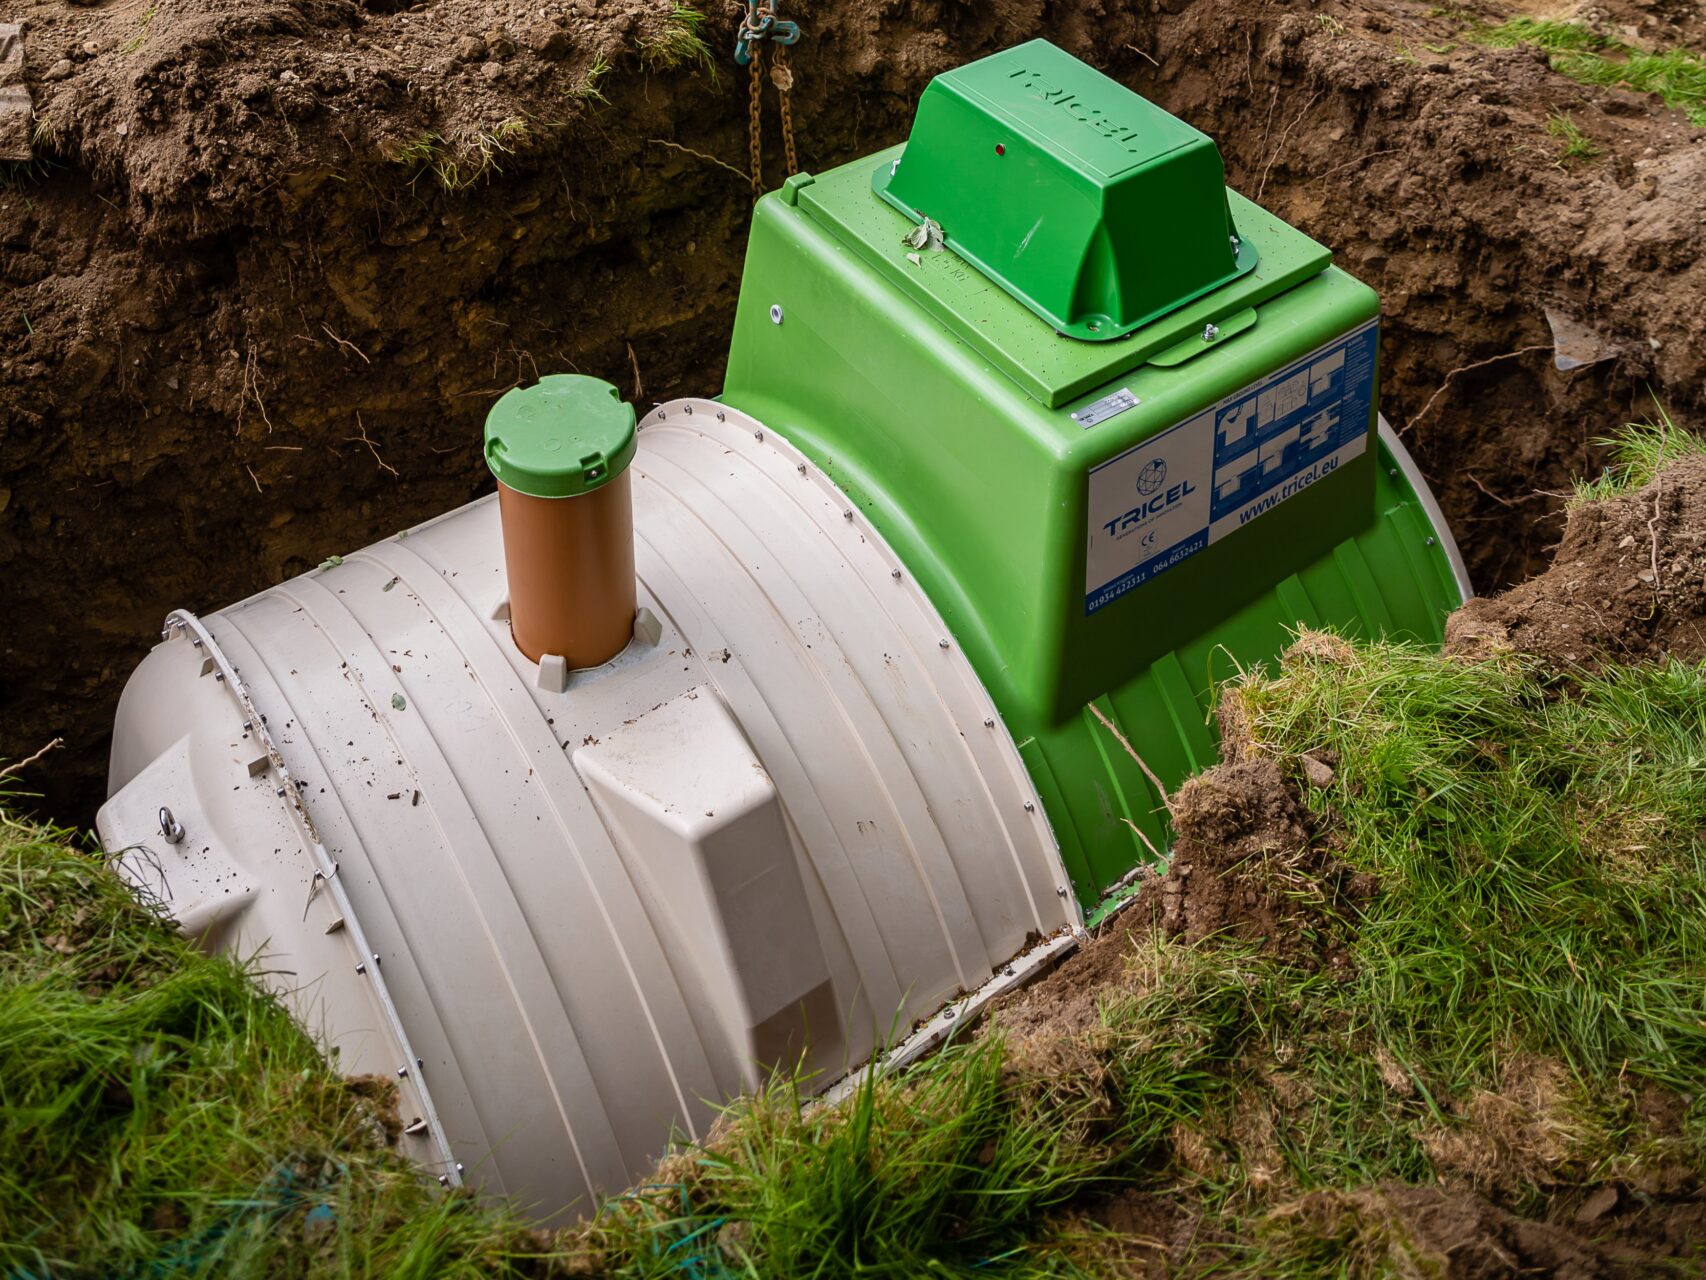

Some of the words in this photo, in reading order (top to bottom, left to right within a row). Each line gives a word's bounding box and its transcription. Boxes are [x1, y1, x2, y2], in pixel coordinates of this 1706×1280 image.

[1009, 60, 1139, 153] TRICEL
[1103, 480, 1196, 536] TRICEL
[1240, 456, 1339, 524] www.tricel.eu
[1088, 591, 1115, 611] 01934
[1115, 572, 1146, 595] 422311
[1152, 560, 1169, 574] 064
